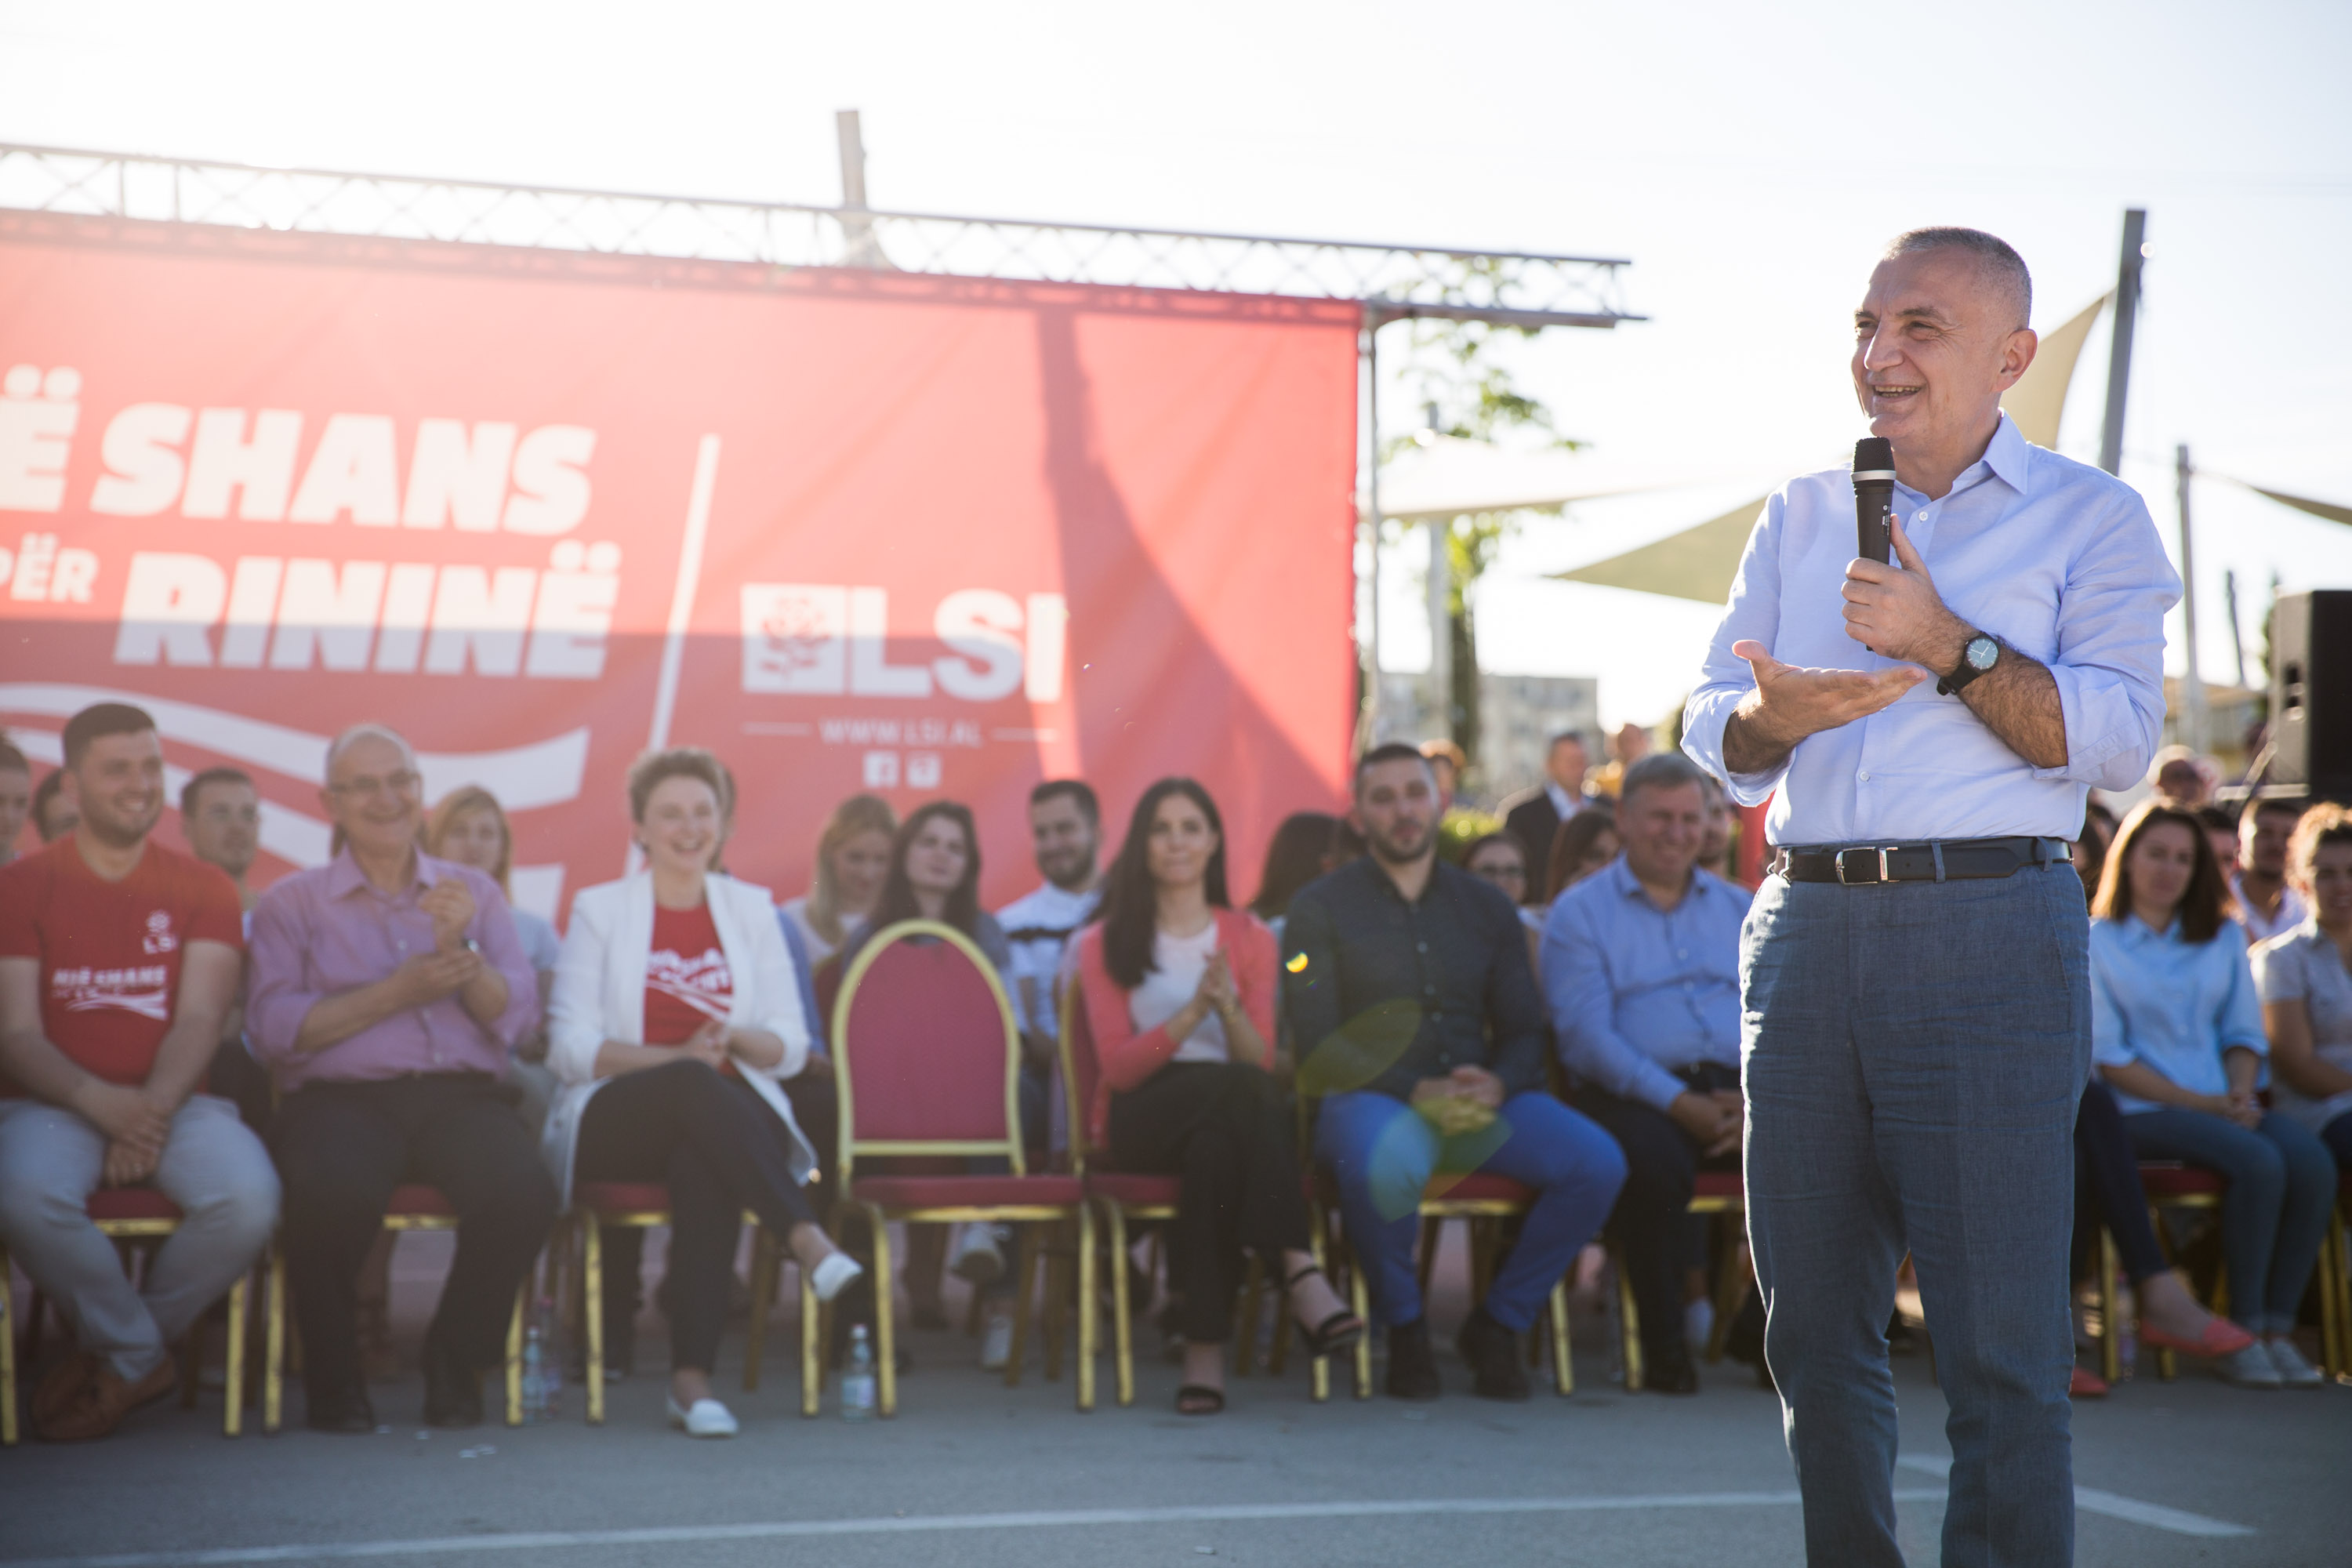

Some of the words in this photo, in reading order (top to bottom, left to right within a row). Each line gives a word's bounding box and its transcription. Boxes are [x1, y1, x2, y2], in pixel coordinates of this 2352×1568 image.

[90, 402, 596, 535] SHANS
[114, 541, 621, 678] RININË
[850, 588, 1065, 701] LSI
